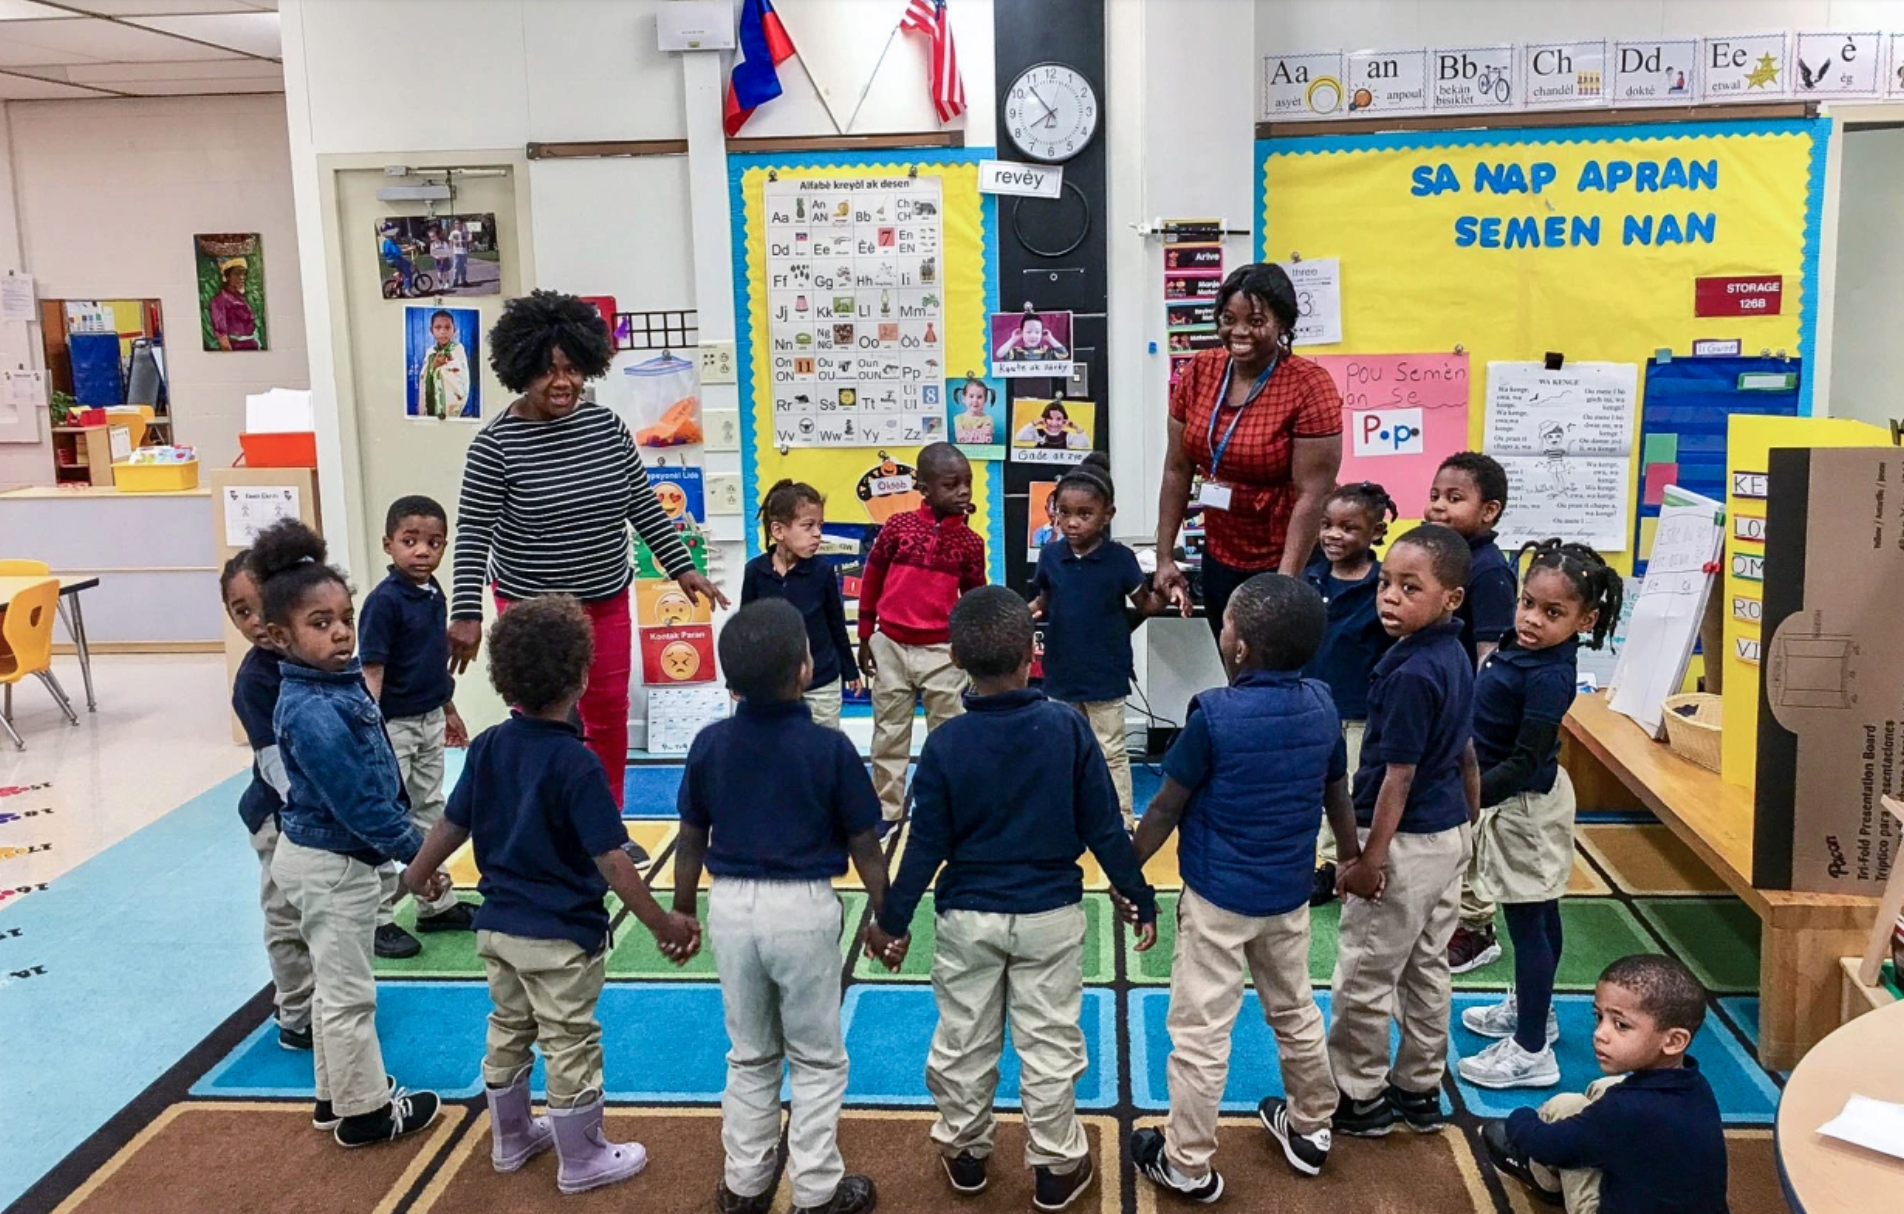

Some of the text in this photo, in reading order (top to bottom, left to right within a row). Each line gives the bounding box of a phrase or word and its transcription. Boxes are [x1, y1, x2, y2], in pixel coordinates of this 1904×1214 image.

[1711, 42, 1747, 68] Ee
[1841, 36, 1857, 62] è
[1532, 49, 1573, 76] Ch
[1620, 46, 1662, 73] Dd
[1270, 60, 1309, 85] Aa
[1367, 58, 1398, 79] an
[1438, 54, 1477, 80] Bb
[1026, 73, 1037, 84] 11
[1045, 68, 1056, 80] 12
[1068, 73, 1073, 84] 1
[1012, 88, 1024, 100] 10
[1081, 87, 1088, 98] 2
[1386, 89, 1422, 103] anpoul
[1009, 108, 1016, 119] 9
[1086, 106, 1093, 117] 3
[1015, 128, 1022, 139] 8
[1081, 126, 1088, 137] 4
[1029, 142, 1036, 152] 7
[1047, 146, 1055, 157] 6
[1066, 141, 1073, 152] 5
[1411, 158, 1718, 197] SA NAP APRAN
[866, 179, 879, 189] ak
[880, 179, 910, 189] desen
[812, 200, 826, 209] An
[897, 199, 910, 208] Ch
[772, 212, 789, 223] Aa
[812, 213, 829, 222] AN
[856, 211, 871, 222] Bb
[897, 212, 912, 221] CH
[899, 230, 913, 240] En
[1454, 212, 1716, 249] SEMEN NAN
[881, 231, 892, 245] 7
[772, 244, 790, 256] Dd
[814, 244, 830, 255] Ee
[899, 243, 915, 253] EN
[773, 275, 787, 288] Ff
[814, 275, 833, 290] Gg
[857, 275, 873, 286] Hh
[1727, 282, 1780, 293] STORAGE
[1740, 298, 1766, 309] 126B
[775, 305, 788, 322] Jj
[816, 305, 833, 318] Kk
[900, 305, 926, 317] Mm
[817, 328, 830, 339] Ng
[775, 339, 793, 351] Nn
[817, 340, 833, 349] NG
[858, 336, 879, 349] Oo
[775, 357, 792, 368] On
[798, 361, 812, 373] 11
[817, 358, 833, 368] Ou
[858, 359, 878, 368] Oun
[775, 371, 795, 382] ON
[818, 370, 835, 381] OU
[858, 371, 881, 380] OUN
[902, 367, 921, 381] Pp
[1346, 362, 1382, 392] Pou
[903, 384, 917, 396] Ui
[925, 388, 936, 403] 8
[776, 399, 792, 411] Rr
[819, 399, 836, 411] Ss
[861, 398, 875, 410] Tt
[777, 430, 795, 442] Vv
[819, 430, 842, 441] Ww
[862, 428, 879, 441] Yy
[903, 429, 921, 440] Zz
[1364, 415, 1412, 450] P p
[1018, 450, 1047, 461] Gade
[1052, 452, 1065, 461] ak
[1734, 519, 1766, 538] LO
[1882, 720, 1895, 795] esentaciones
[1857, 725, 1877, 880] Tri-Fold Presentation Board
[1879, 810, 1891, 837] para
